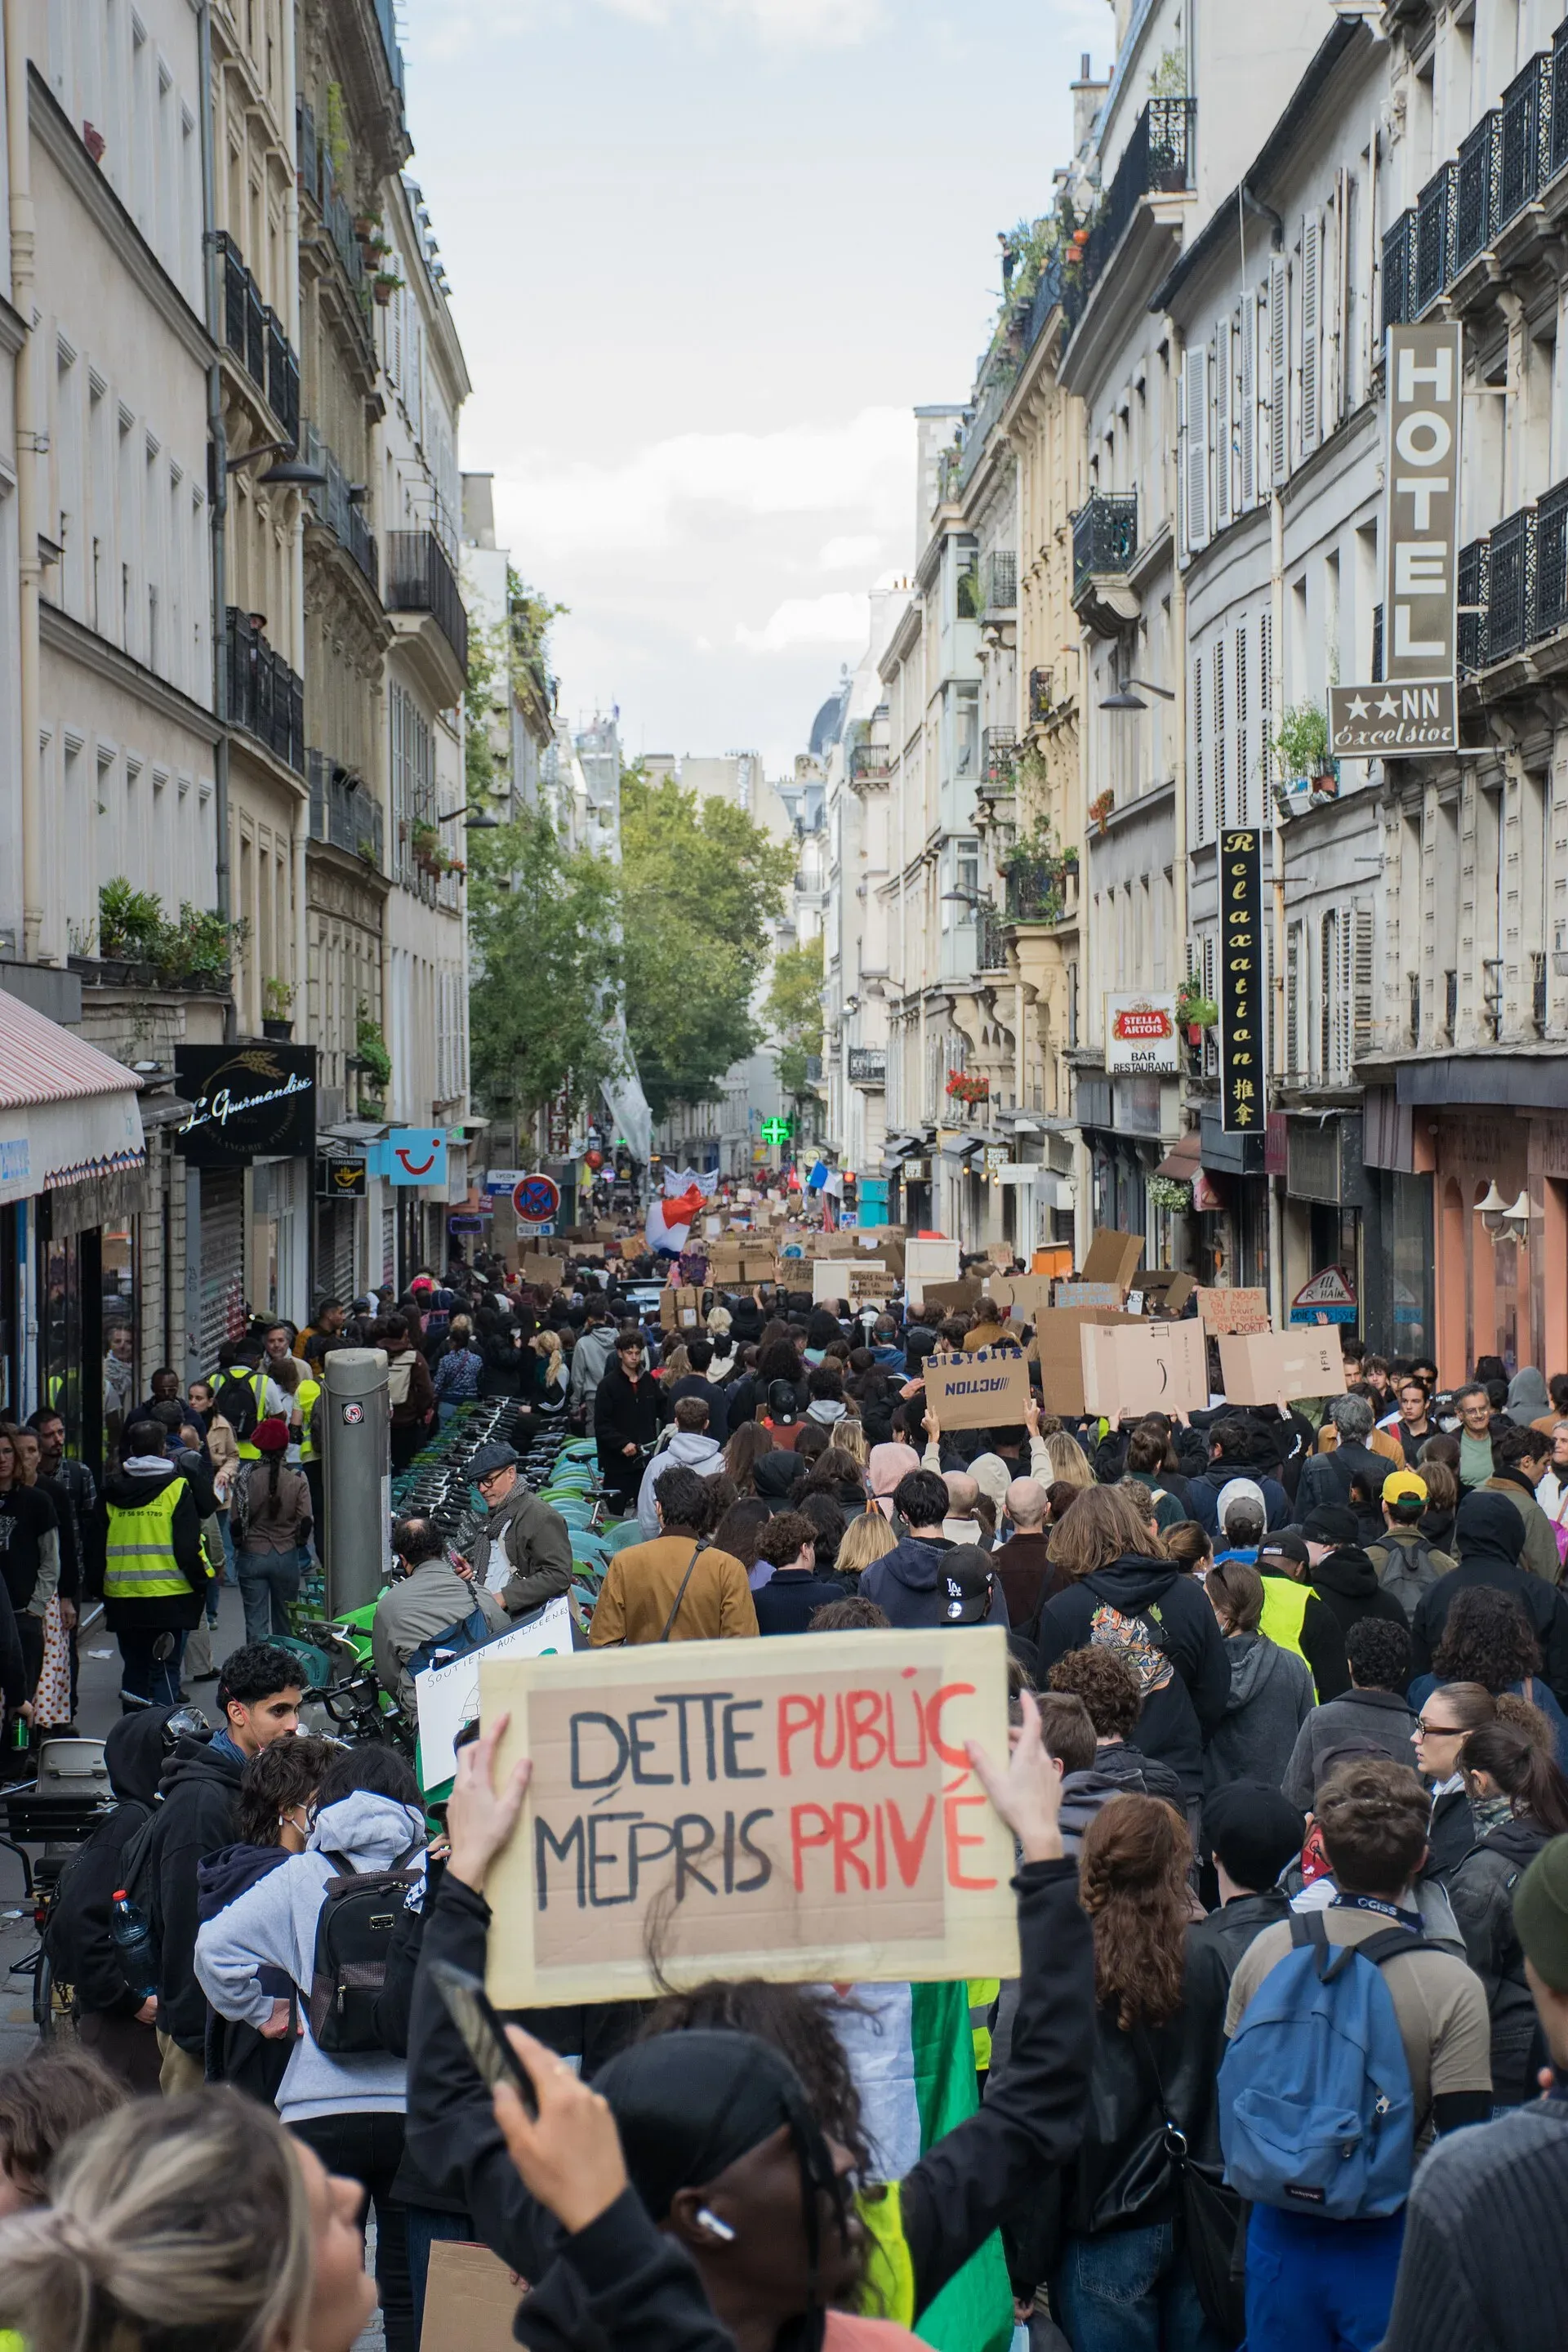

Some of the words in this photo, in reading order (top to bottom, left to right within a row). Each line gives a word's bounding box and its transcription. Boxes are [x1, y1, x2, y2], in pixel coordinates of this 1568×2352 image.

[1394, 347, 1452, 657] HOTEL
[1401, 687, 1440, 720] NN
[1334, 720, 1453, 747] Excelsior
[1223, 831, 1256, 1066] Relaxation
[1124, 1015, 1162, 1025] STELLA
[1124, 1024, 1163, 1035] ARTOIS
[1131, 1051, 1156, 1062] BAR
[1113, 1061, 1174, 1073] RESTAURANT
[212, 1071, 314, 1126] Gourmandise
[1232, 1077, 1255, 1127] 推拿
[1232, 1291, 1261, 1301] NOUS
[1235, 1322, 1264, 1333] DORT
[1319, 1349, 1329, 1365] F18
[945, 1378, 1000, 1396] ACTION
[947, 1577, 962, 1597] LA
[427, 1648, 487, 1688] SOUTIEN
[497, 1633, 517, 1650] AUX
[568, 1691, 768, 1790] DETTE
[533, 1786, 776, 1912] MÉPRIS
[790, 1771, 999, 1894] PRIVÉ
[1368, 1900, 1398, 1917] GISS
